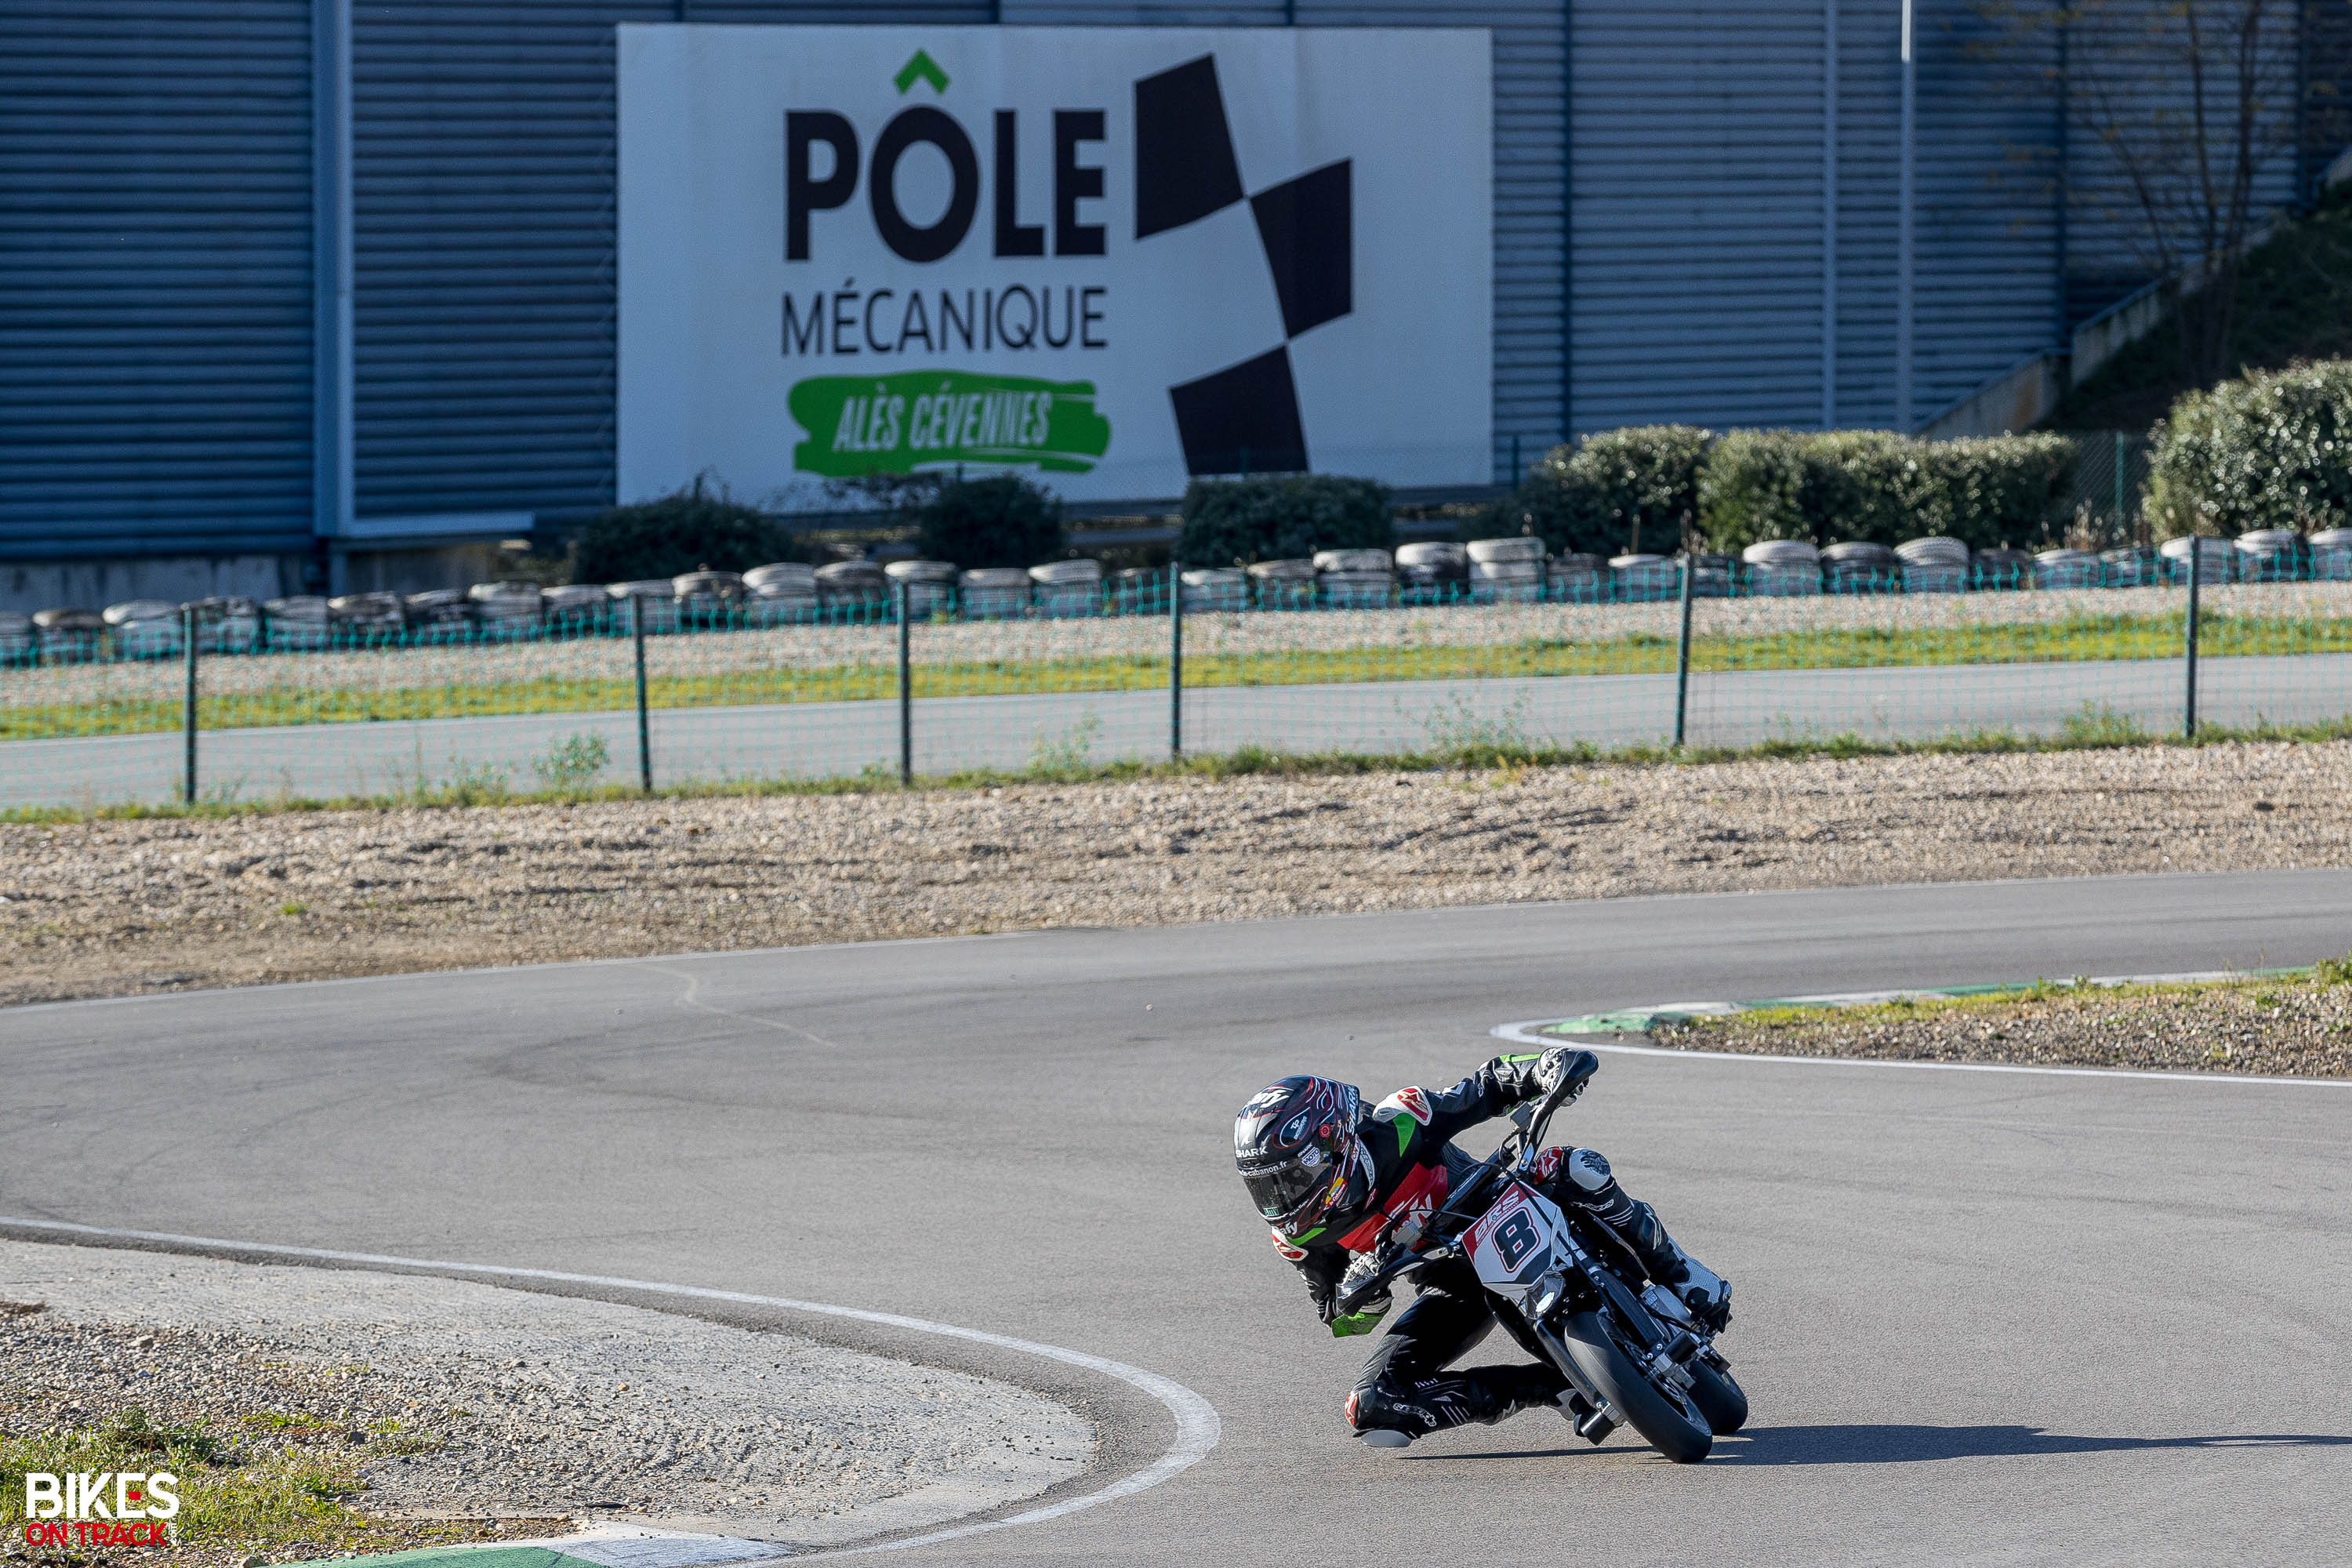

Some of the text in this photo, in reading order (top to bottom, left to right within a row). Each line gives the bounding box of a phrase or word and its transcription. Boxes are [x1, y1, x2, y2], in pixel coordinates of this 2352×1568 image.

[786, 49, 1106, 263] PÔLE
[781, 278, 1108, 357] MÉCANIQUE
[831, 380, 1054, 452] ALÈS CÉVENNES
[1235, 1145, 1269, 1158] SHARK
[1303, 1148, 1320, 1164] MOTO
[1494, 1209, 1538, 1270] 8
